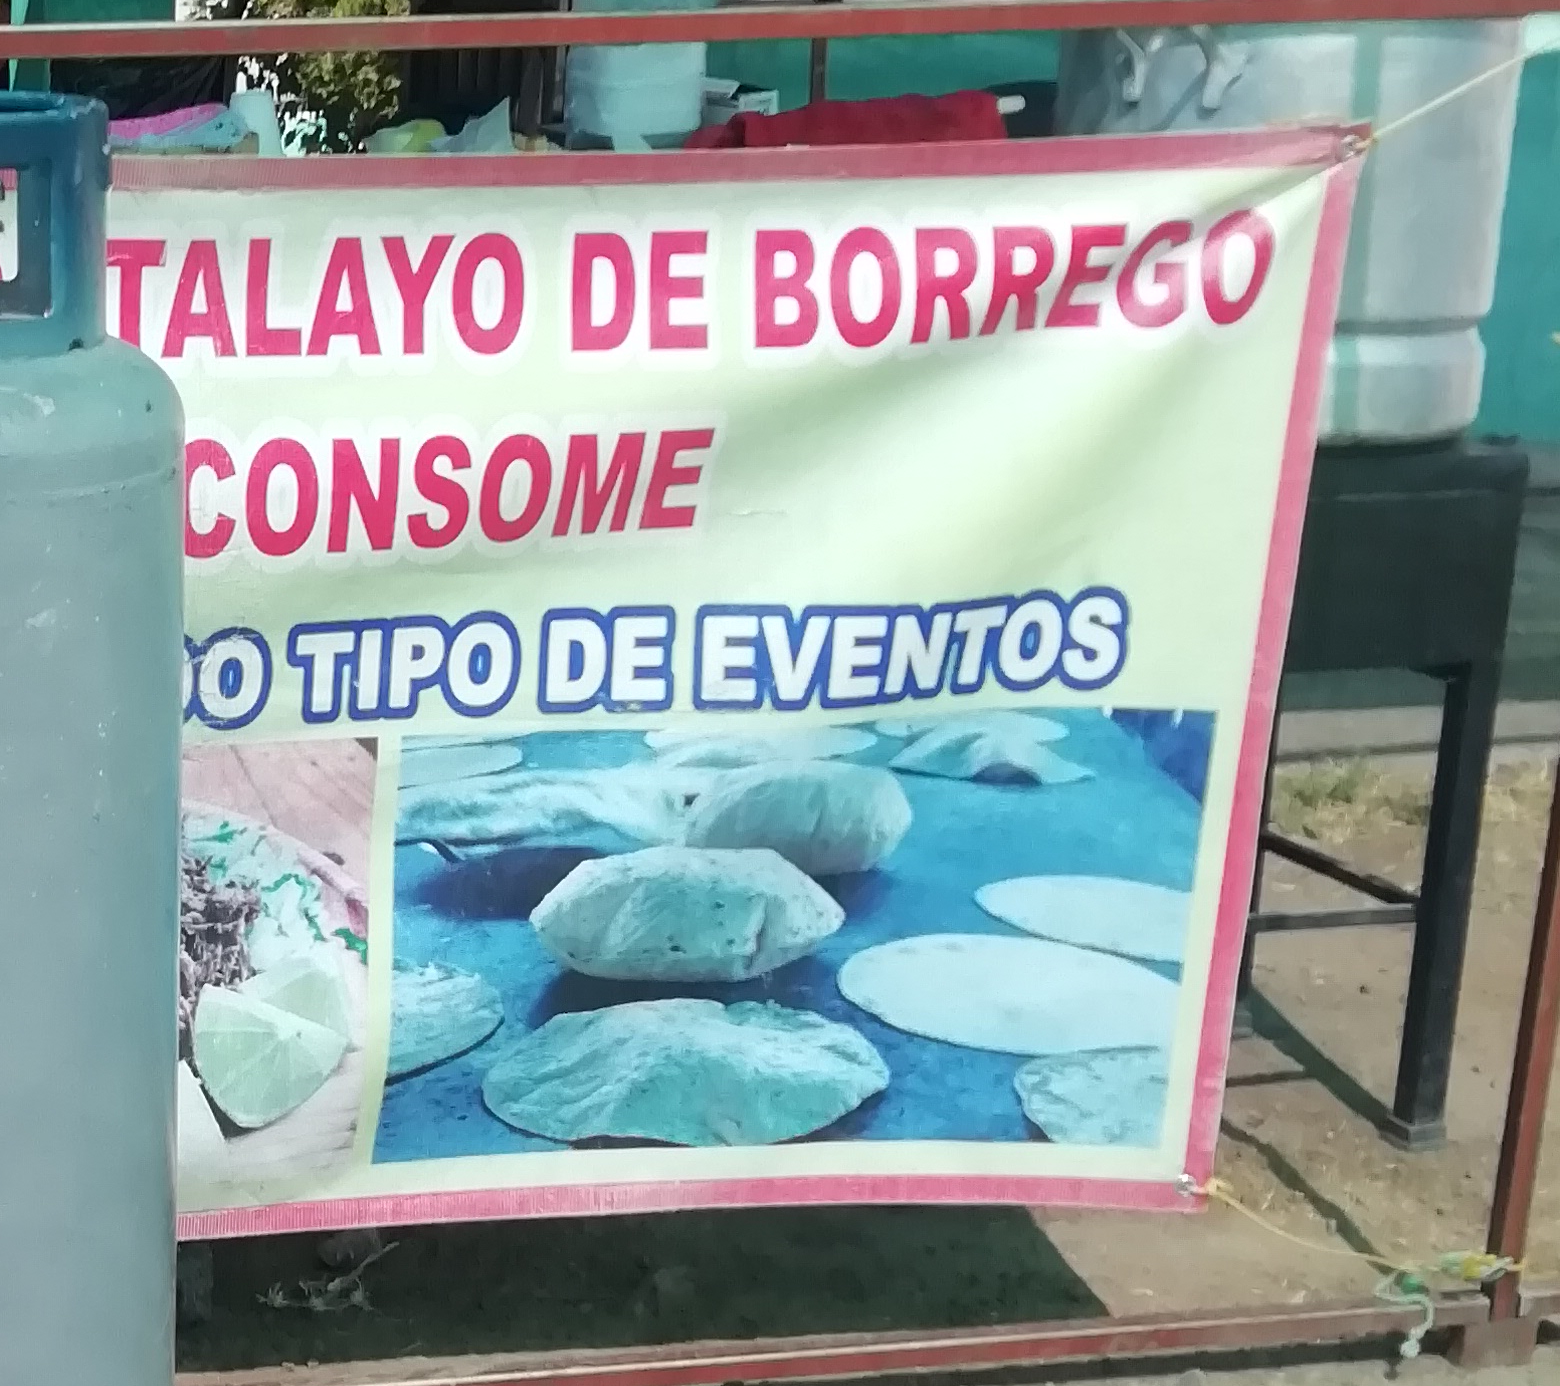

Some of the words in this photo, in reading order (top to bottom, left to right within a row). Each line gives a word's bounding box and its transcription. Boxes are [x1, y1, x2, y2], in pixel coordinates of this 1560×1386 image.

[571, 229, 708, 351] DE
[755, 209, 1275, 348] BORREGO
[185, 429, 713, 558] CONSOME
[287, 610, 518, 724] TIPO
[537, 605, 676, 714] DE
[692, 587, 1128, 712] EVENTOS
